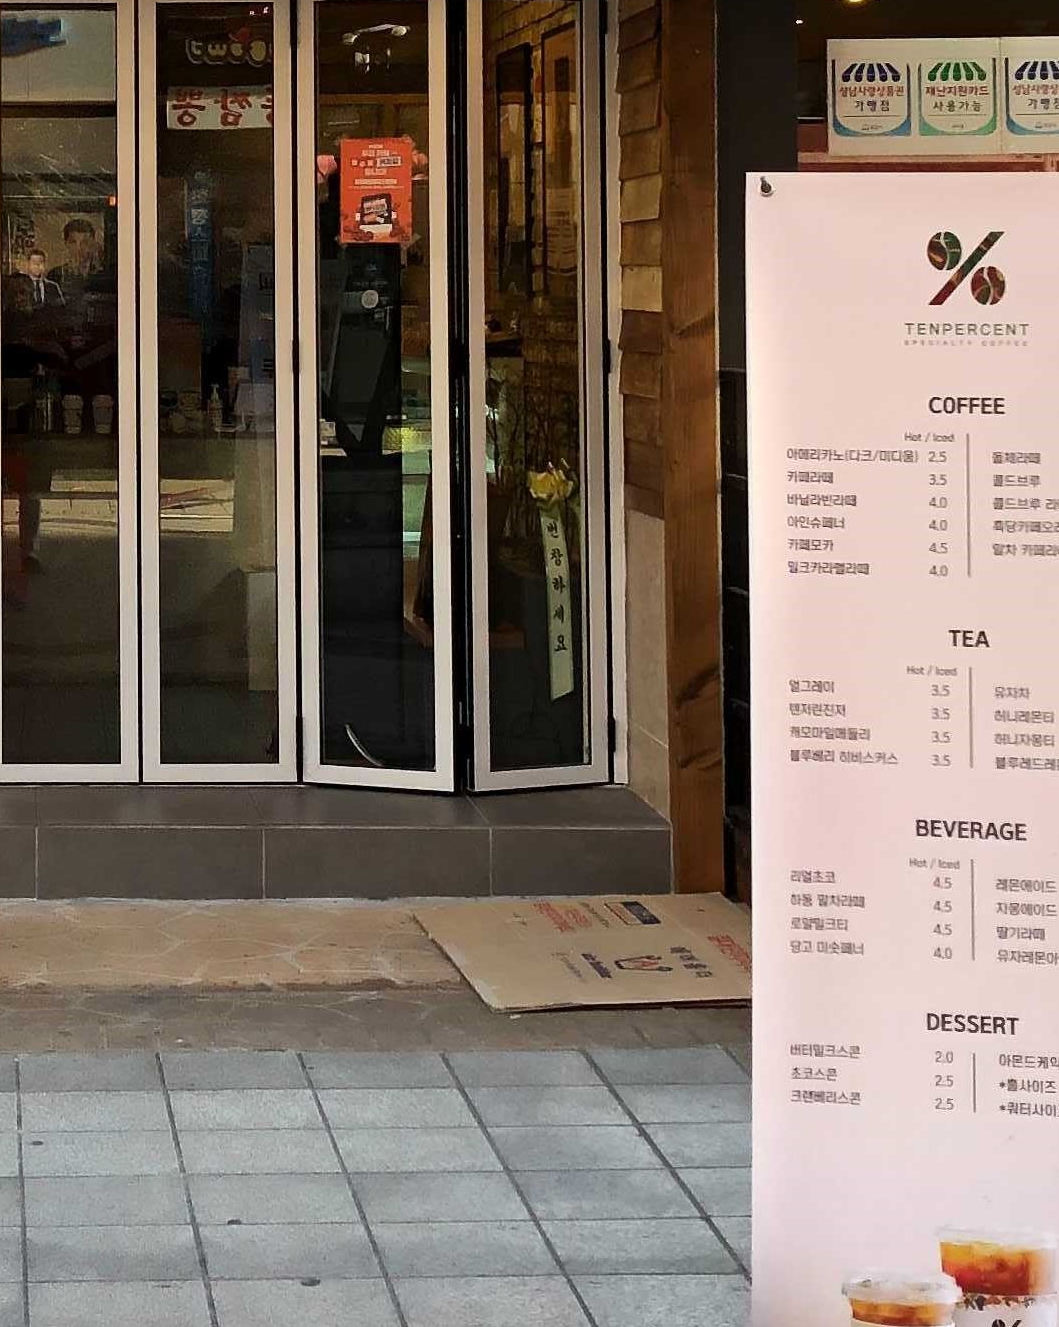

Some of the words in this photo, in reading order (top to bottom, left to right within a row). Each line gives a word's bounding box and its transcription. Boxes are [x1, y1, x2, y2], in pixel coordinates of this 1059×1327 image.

[925, 85, 990, 97] 재난지원카드
[933, 99, 983, 112] 사용가능
[904, 322, 1030, 336] TENPERCENT
[928, 396, 1006, 415] COFFEE
[928, 451, 947, 463] 2.5
[928, 474, 947, 486] 3.5
[928, 497, 948, 509] 4.0
[929, 519, 948, 532] 4.0
[929, 542, 948, 554] 4.5
[929, 565, 948, 577] 4.0
[546, 520, 568, 652] 번창하세요
[948, 629, 990, 648] TEA
[931, 684, 950, 697] 3.5
[931, 707, 950, 720] 3.5
[931, 730, 951, 744] 3.5
[931, 754, 951, 767] 3.5
[915, 819, 1028, 842] BEVERAGE
[932, 877, 953, 890] 4.5
[932, 900, 953, 913] 4.5
[932, 923, 953, 936] 4.5
[932, 947, 953, 960] 4.0
[926, 1013, 1020, 1035] DESSERT
[934, 1051, 954, 1064] 2.0
[934, 1074, 954, 1087] 2.5
[934, 1098, 954, 1111] 2.5
